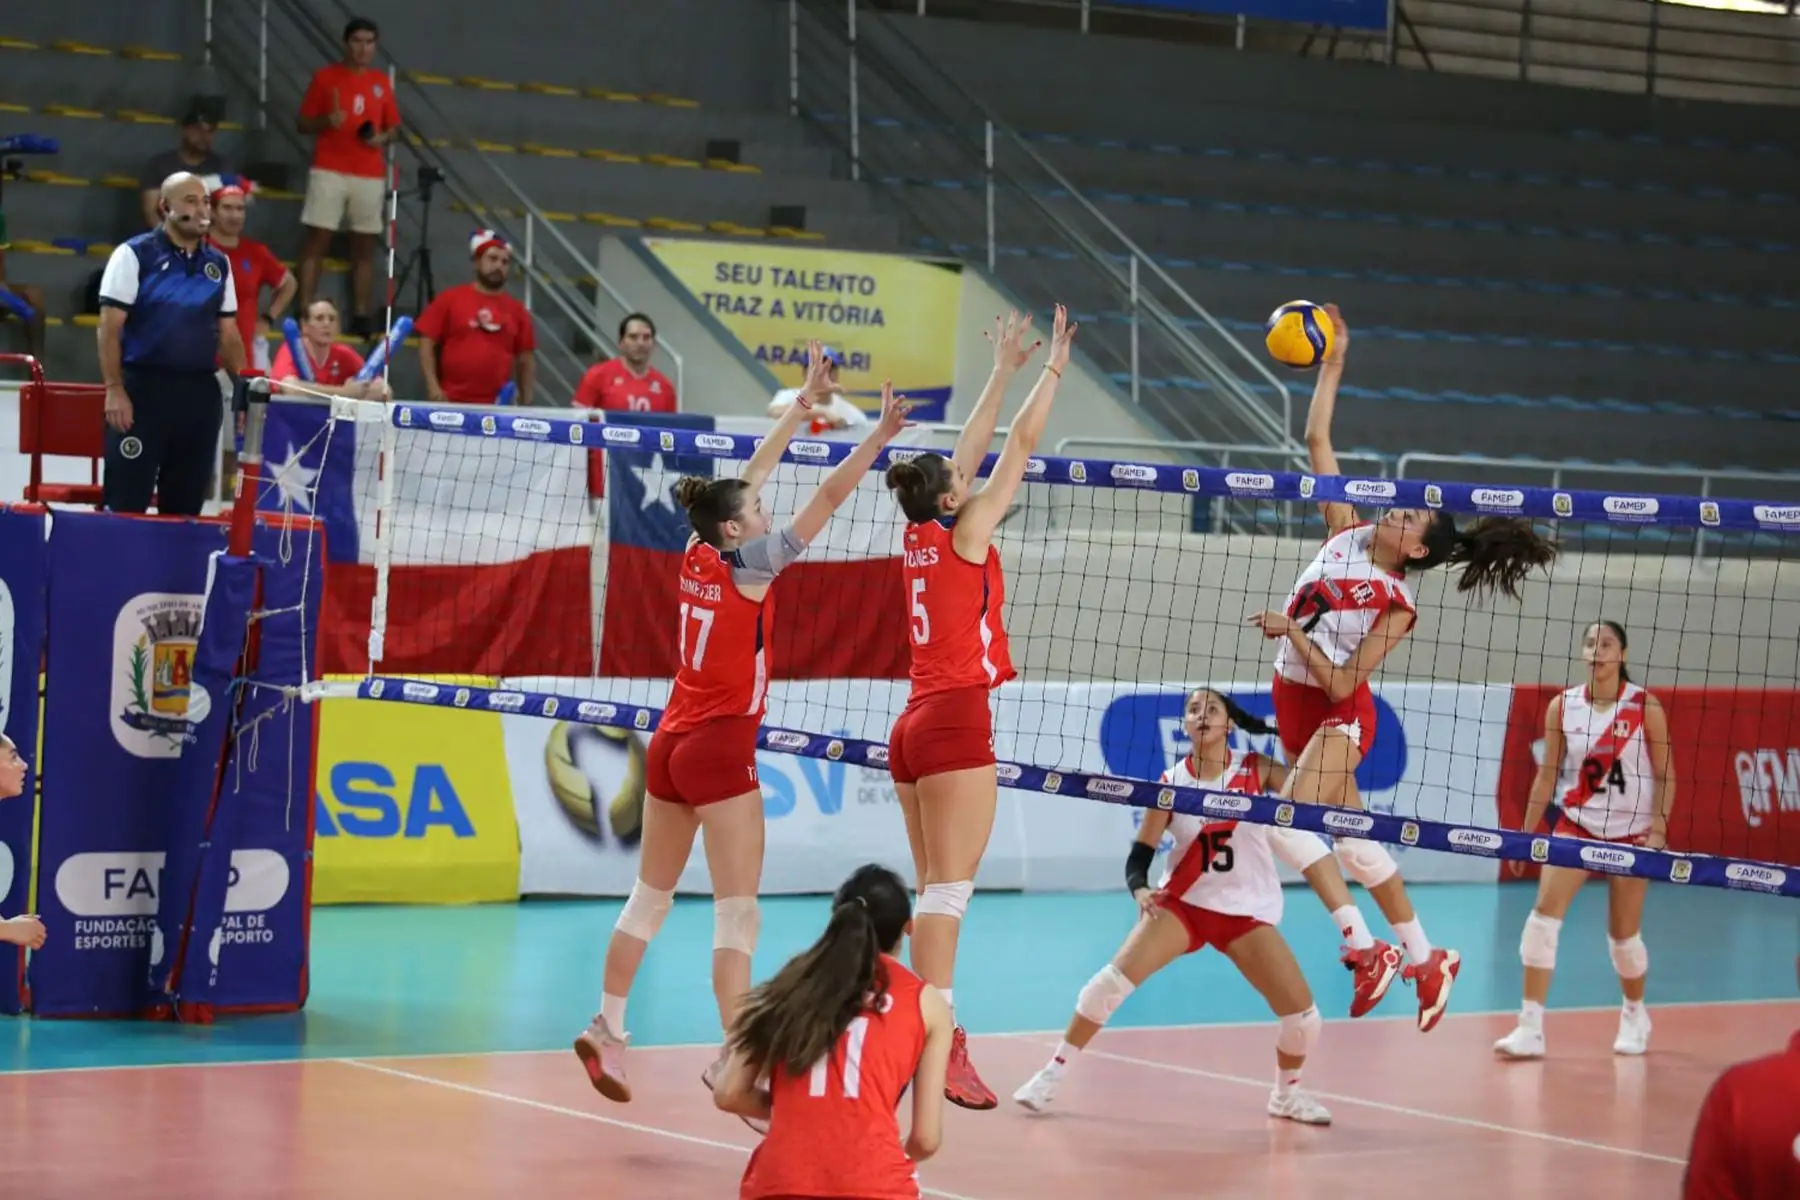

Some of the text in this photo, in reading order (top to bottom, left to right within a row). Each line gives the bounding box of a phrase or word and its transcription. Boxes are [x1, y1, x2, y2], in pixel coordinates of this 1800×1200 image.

[714, 262, 876, 296] SEU TALENTO
[701, 291, 885, 327] TRAZ A VITÓRIA
[754, 343, 872, 373] ARAARI
[1235, 476, 1265, 487] FAMEP
[1355, 483, 1386, 494] FAMEP
[1481, 493, 1515, 504] FAMEP
[1613, 500, 1646, 511] FAMEP
[912, 578, 931, 645] 5
[680, 602, 715, 672] 17
[1583, 757, 1626, 795] 24
[1457, 832, 1491, 845] FAMEP
[1197, 829, 1234, 873] 15
[1591, 850, 1625, 862] FAMEP
[104, 867, 163, 899] FA
[247, 914, 265, 928] DE
[75, 935, 146, 949] ESPORTES
